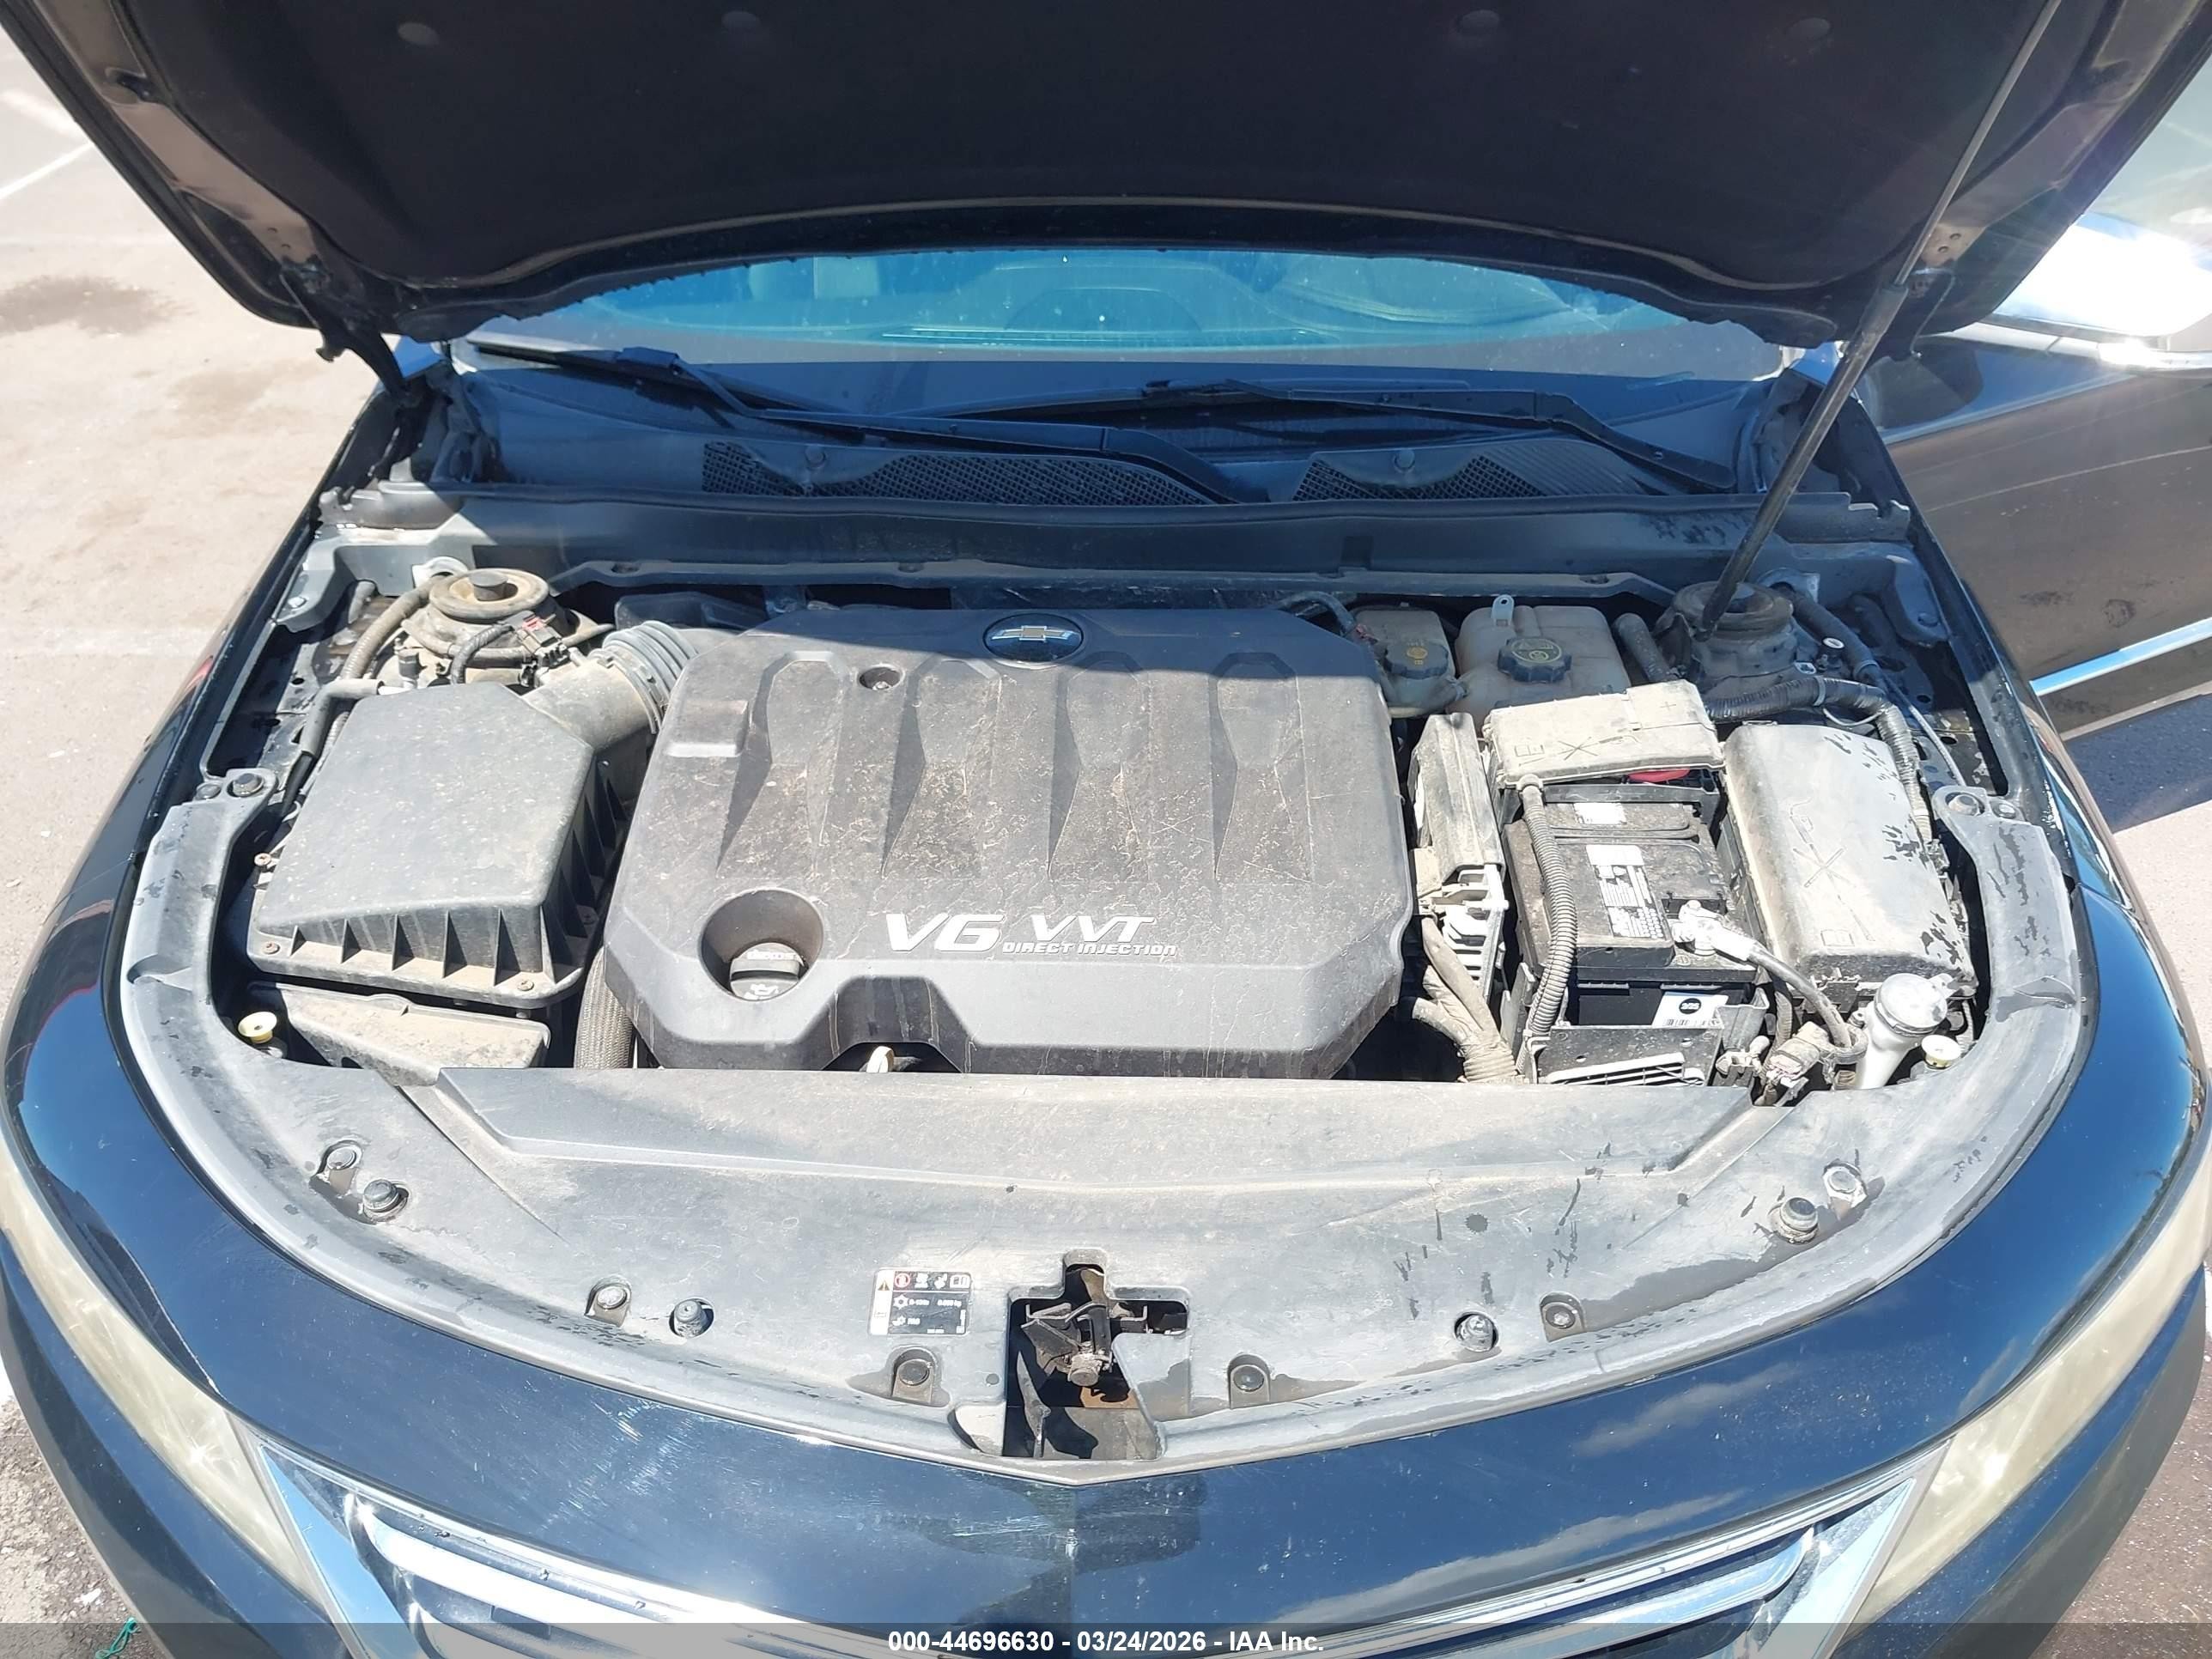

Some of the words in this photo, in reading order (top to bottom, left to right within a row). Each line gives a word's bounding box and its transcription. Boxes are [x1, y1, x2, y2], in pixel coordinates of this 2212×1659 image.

[885, 913, 1005, 952] V6
[1030, 915, 1156, 943] VVT
[1002, 941, 1073, 955] DIRECT
[1078, 943, 1176, 957] INJECTION
